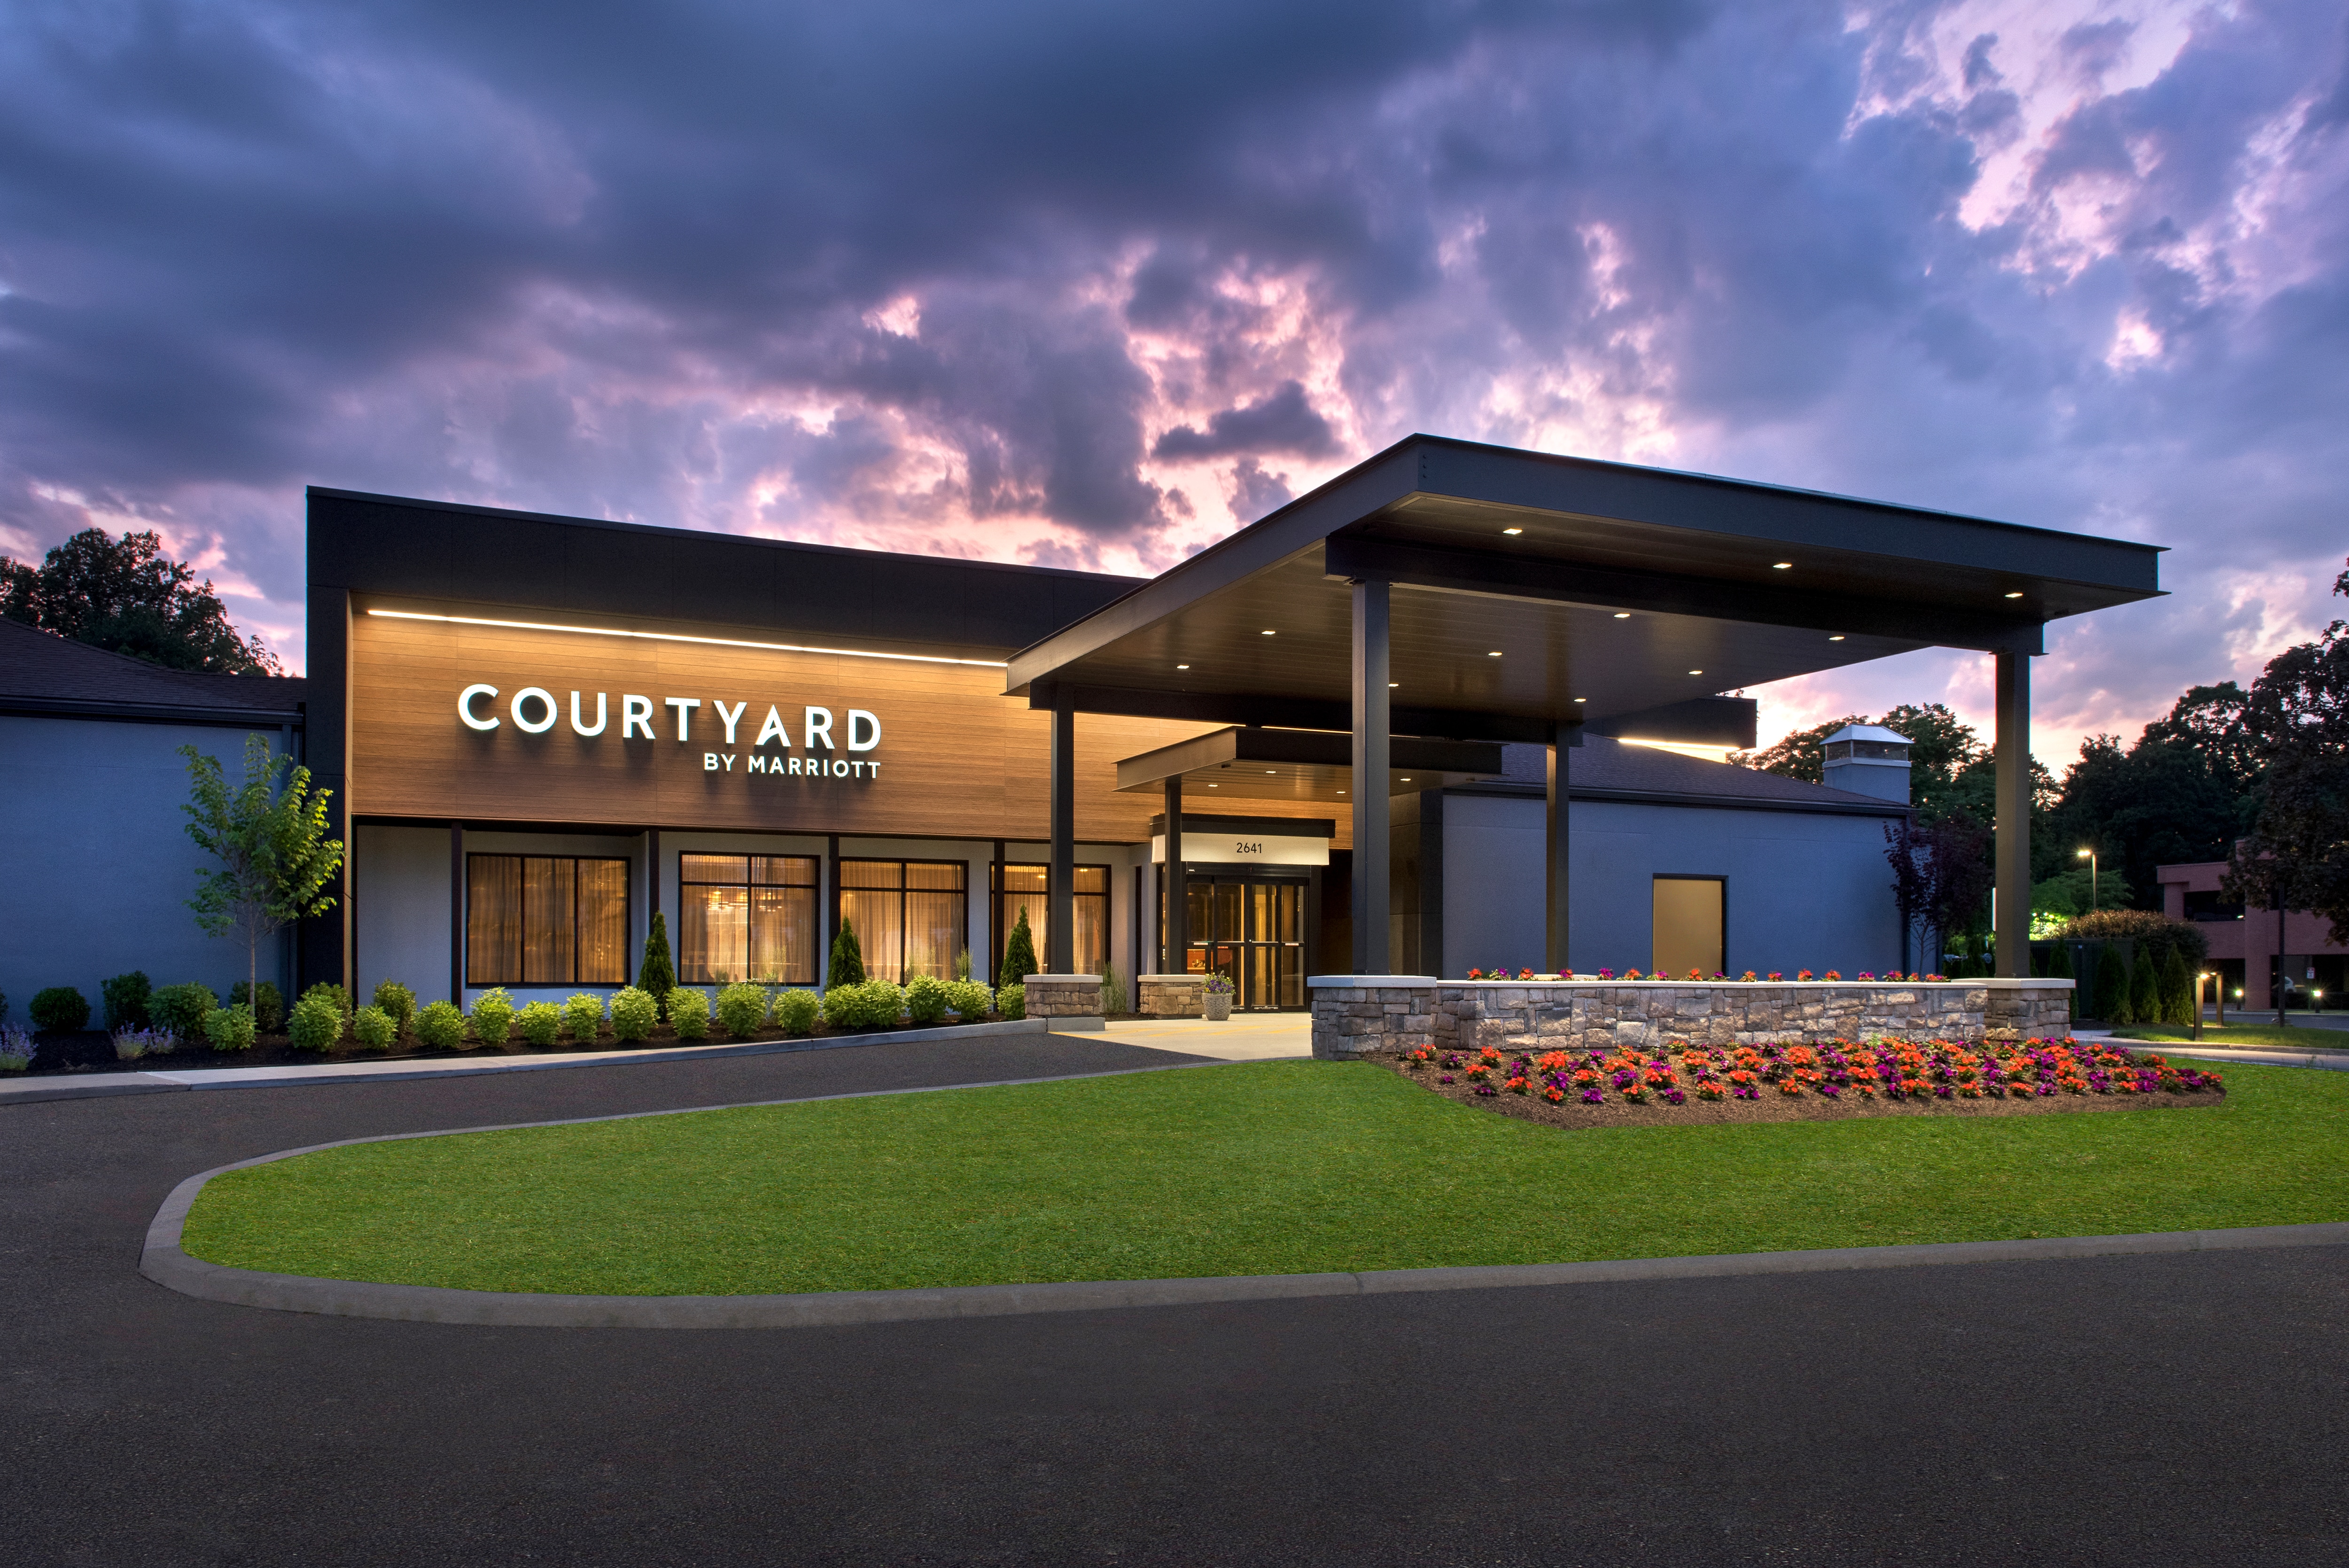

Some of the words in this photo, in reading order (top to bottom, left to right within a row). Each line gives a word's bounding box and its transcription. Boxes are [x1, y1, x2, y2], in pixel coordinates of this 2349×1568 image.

[458, 683, 881, 751] COURTYARD
[704, 753, 736, 771] BY
[748, 755, 881, 778] MARRIOTT
[1237, 842, 1261, 854] 2641
